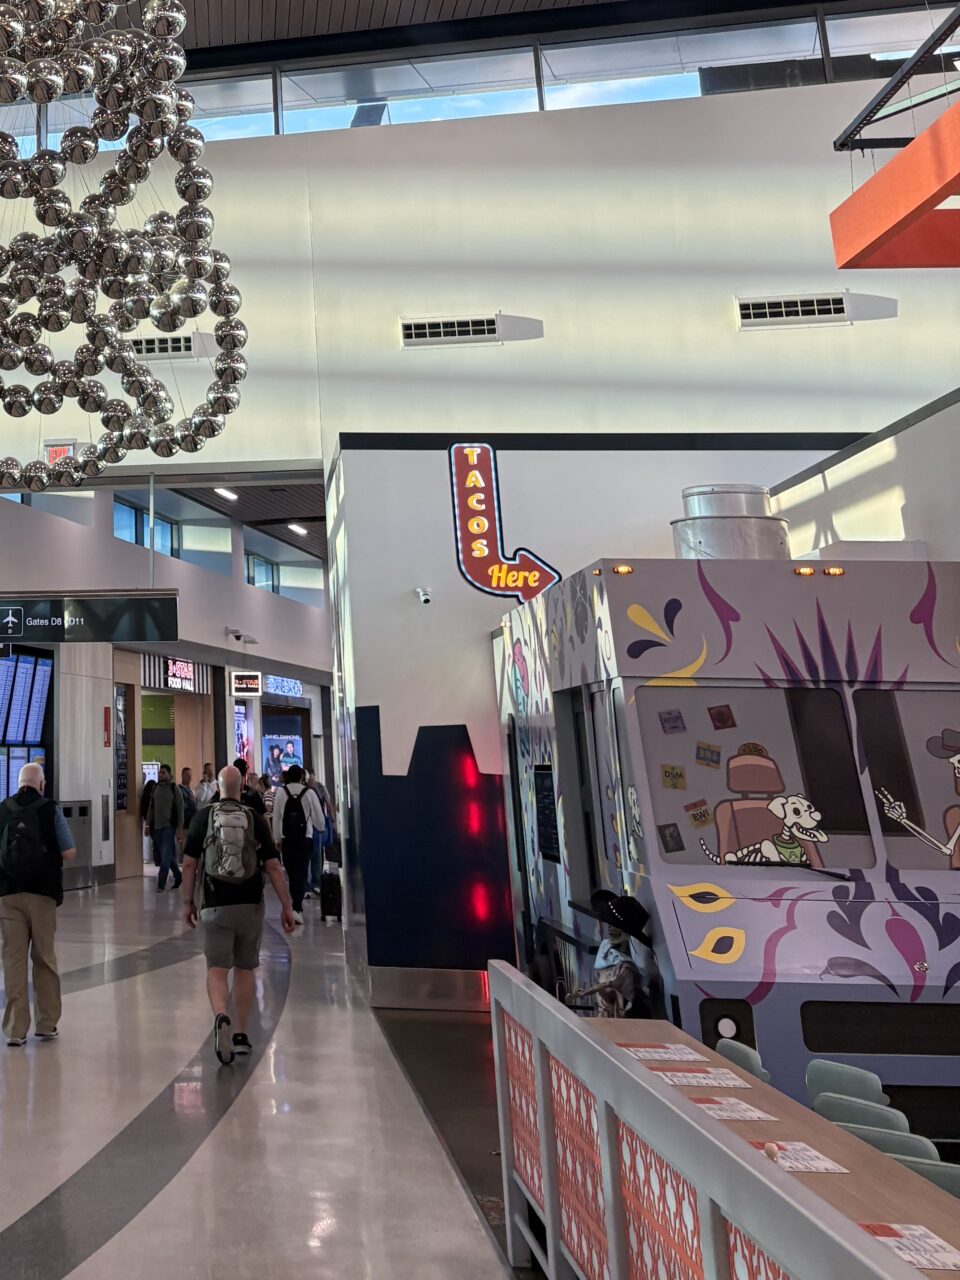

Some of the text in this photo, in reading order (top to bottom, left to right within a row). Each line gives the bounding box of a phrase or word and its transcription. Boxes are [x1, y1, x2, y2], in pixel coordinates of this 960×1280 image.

[463, 447, 489, 558] TACOS
[488, 564, 540, 588] Here
[26, 617, 84, 626] Gates D8 D11
[168, 676, 194, 692] FOOD HALL
[692, 809, 710, 823] BWI
